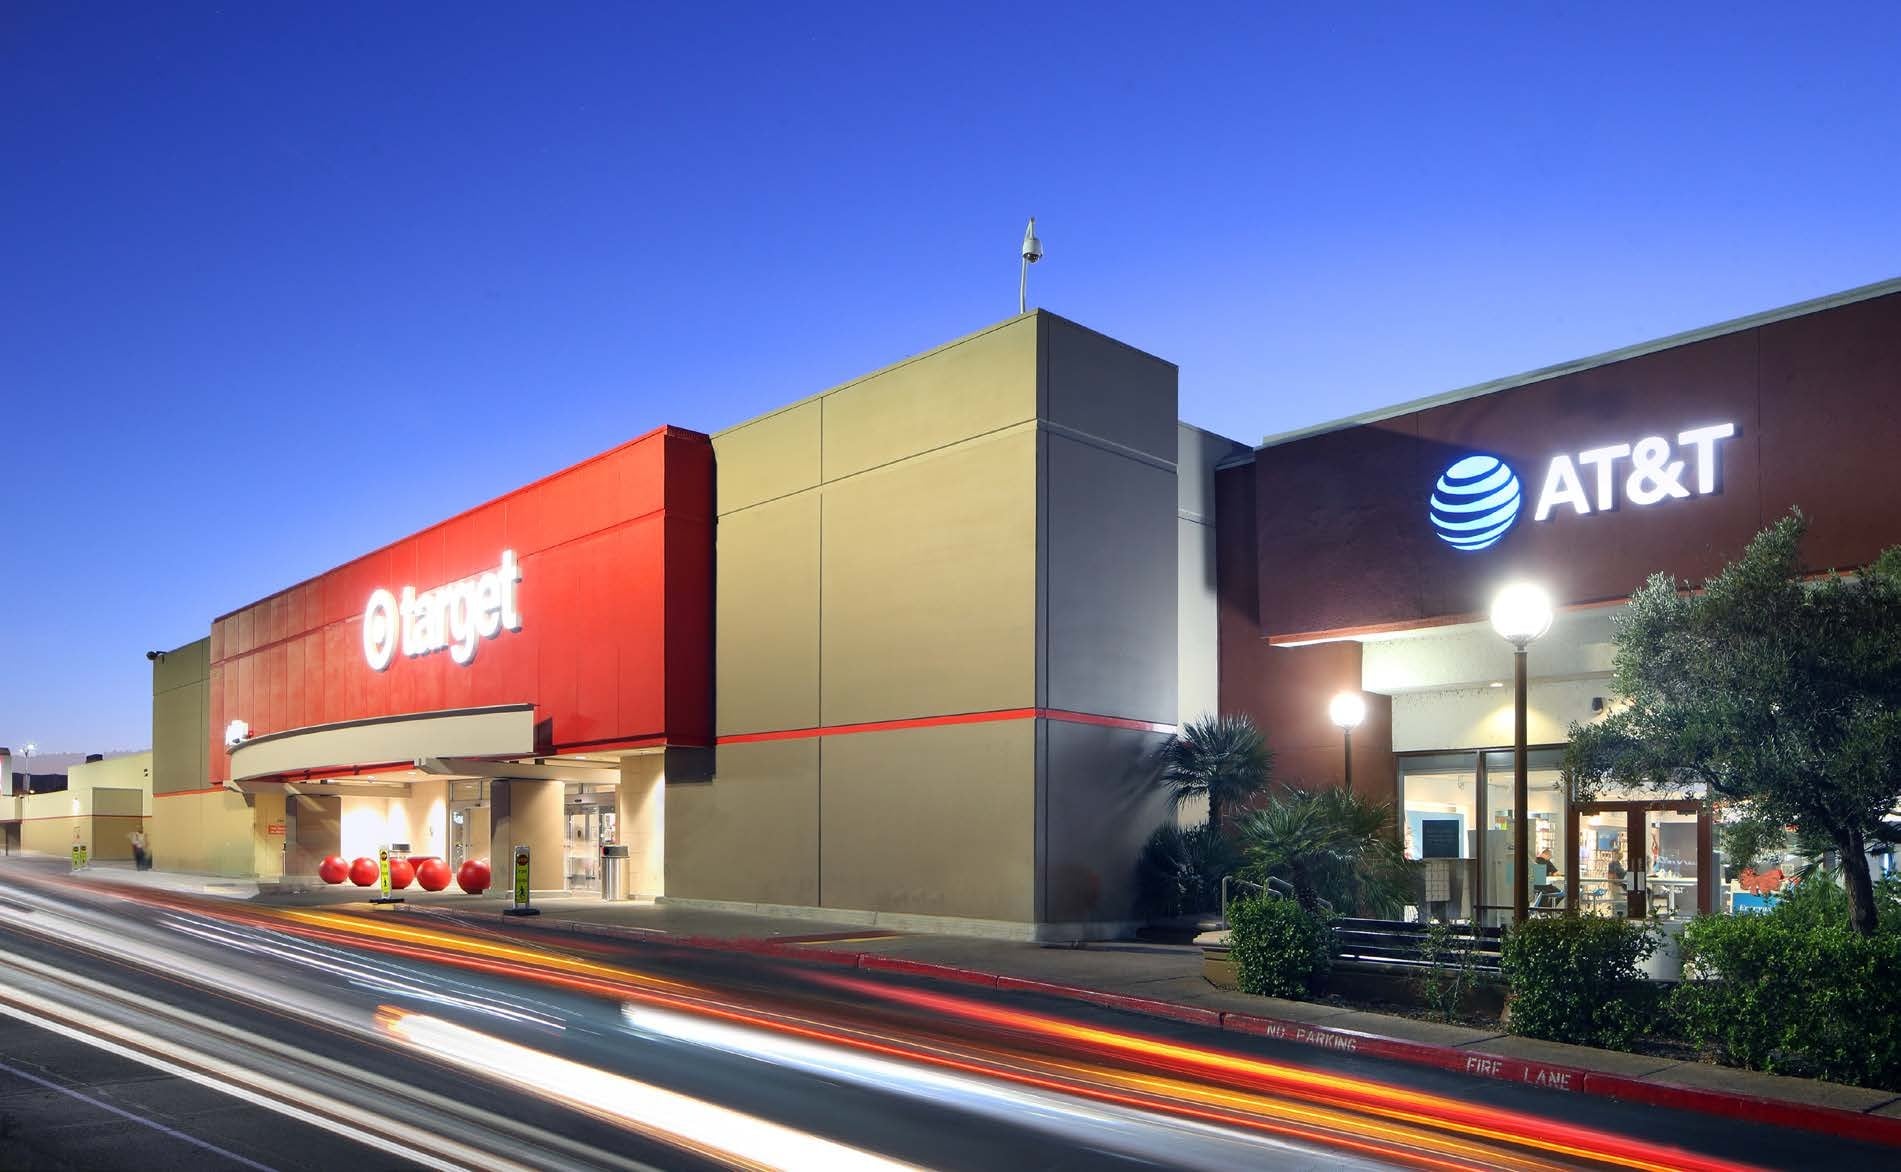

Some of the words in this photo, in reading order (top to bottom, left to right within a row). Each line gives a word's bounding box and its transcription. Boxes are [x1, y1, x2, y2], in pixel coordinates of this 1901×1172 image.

[1534, 422, 1737, 522] AT&T
[400, 549, 521, 666] target
[1266, 1025, 1287, 1038] NO
[1296, 1028, 1357, 1050] PARKING
[1466, 1056, 1503, 1075] FIRE
[1523, 1066, 1572, 1091] LANE
